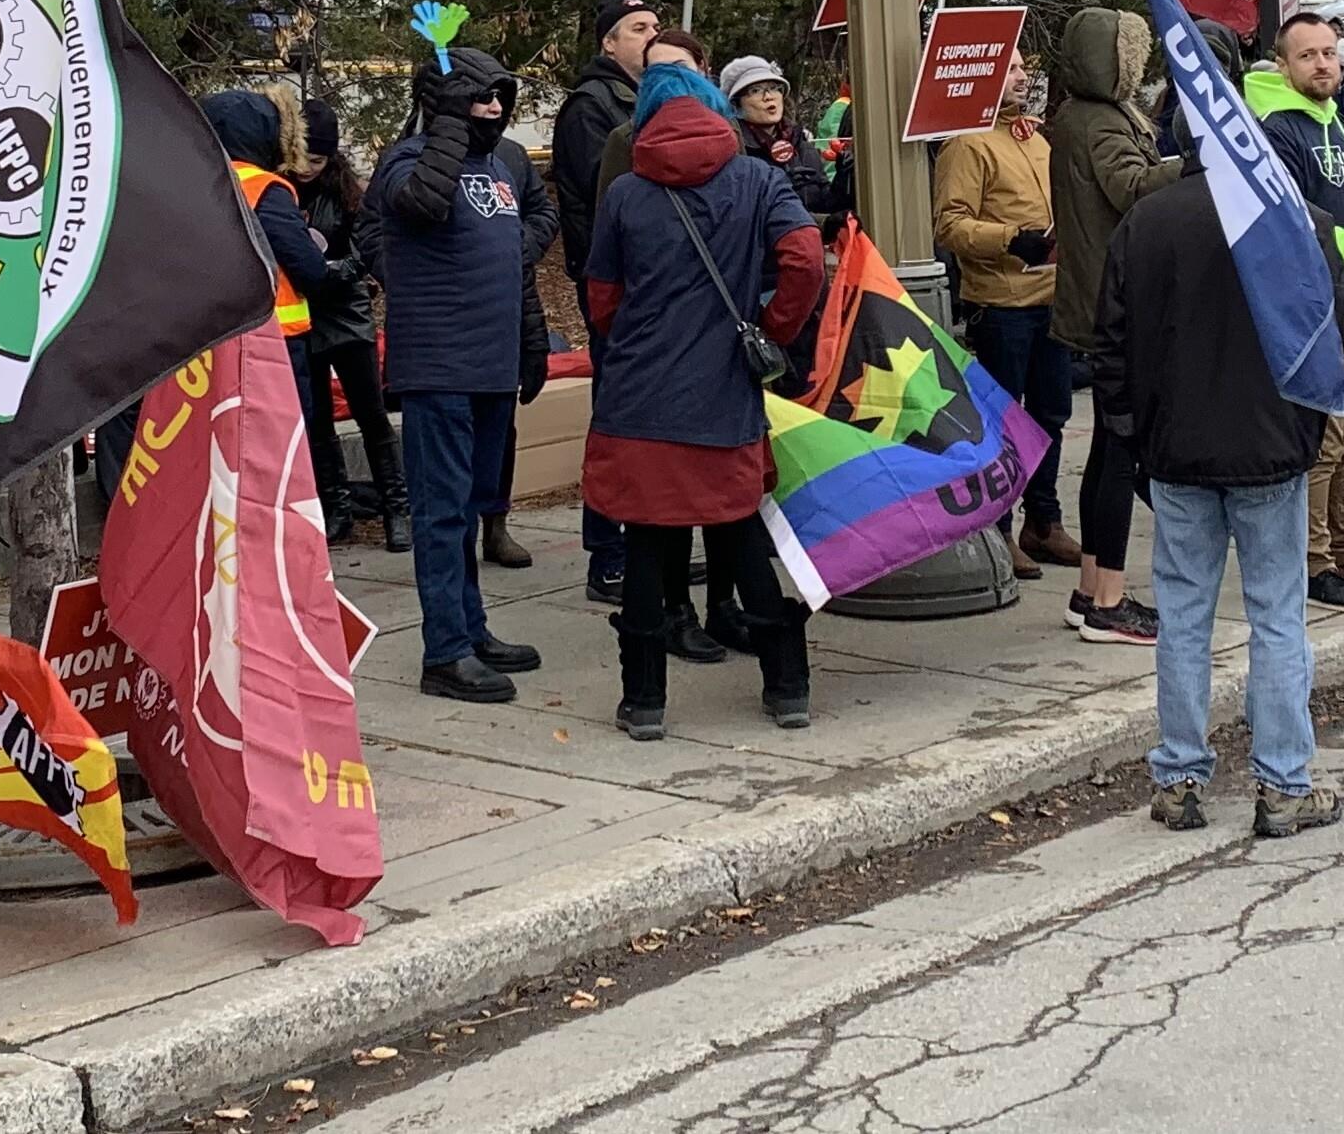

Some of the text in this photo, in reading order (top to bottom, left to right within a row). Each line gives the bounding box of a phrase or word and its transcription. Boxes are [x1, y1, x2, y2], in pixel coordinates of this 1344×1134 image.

[936, 42, 1005, 61] I SUPPORT MY
[934, 61, 995, 80] BARGAINING
[946, 81, 974, 98] TEAM
[1164, 21, 1285, 206] UNDE
[50, 643, 116, 681] MON
